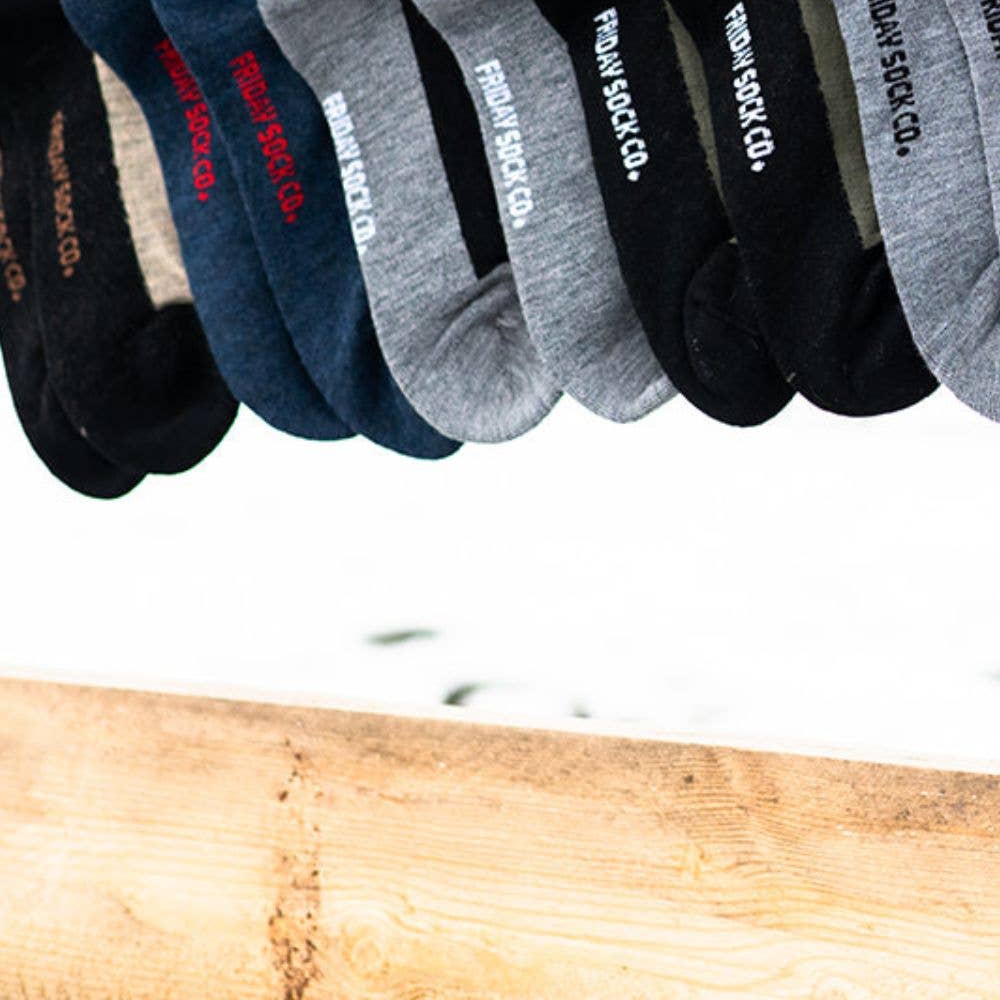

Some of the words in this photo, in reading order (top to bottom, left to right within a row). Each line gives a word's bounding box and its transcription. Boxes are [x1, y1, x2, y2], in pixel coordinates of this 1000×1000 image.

[593, 6, 625, 79] FRIDAY
[723, 0, 754, 72] FRIDAY
[474, 58, 517, 132] FRIDAY
[603, 77, 641, 141] SOCK
[732, 68, 766, 129] SOCK
[880, 49, 915, 110] SOCK
[229, 50, 278, 124] FRIDAY
[256, 122, 296, 184] SOCK
[277, 181, 304, 224] CO.
[494, 128, 528, 188] SOCK
[621, 138, 650, 183] CO.
[744, 126, 776, 173] CO.
[891, 110, 922, 157] CO.
[191, 158, 216, 203] CO.
[507, 186, 535, 229] CO.
